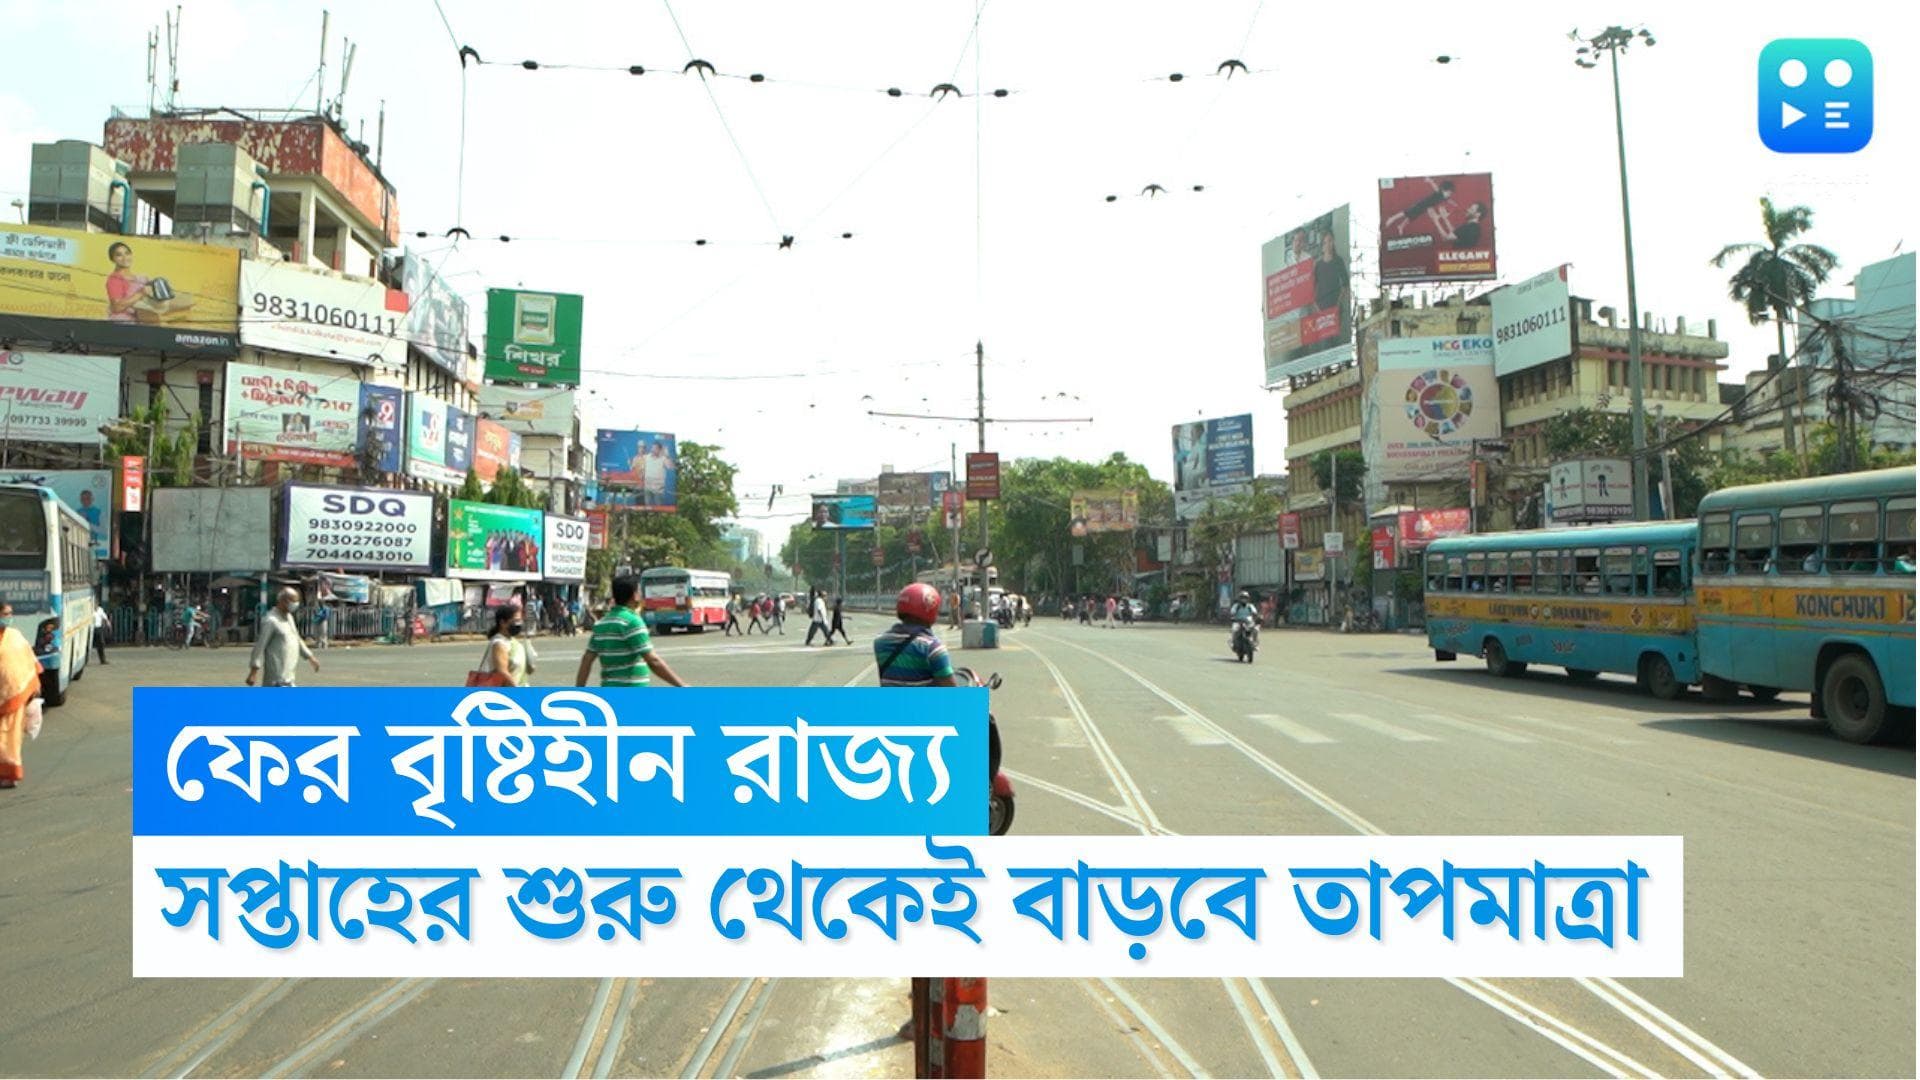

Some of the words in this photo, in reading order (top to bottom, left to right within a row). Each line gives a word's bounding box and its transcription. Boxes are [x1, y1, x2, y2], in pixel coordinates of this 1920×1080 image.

[253, 292, 398, 338] 9831060111
[1496, 306, 1567, 345] 9831060111
[175, 333, 229, 348] amazon.in
[504, 344, 562, 368] শিখর
[323, 494, 407, 518] SDQ
[309, 518, 417, 534] 9830922000
[307, 533, 413, 548] 9830276087
[305, 548, 413, 562] 7044043010
[1795, 593, 1886, 620] KONCHUKI
